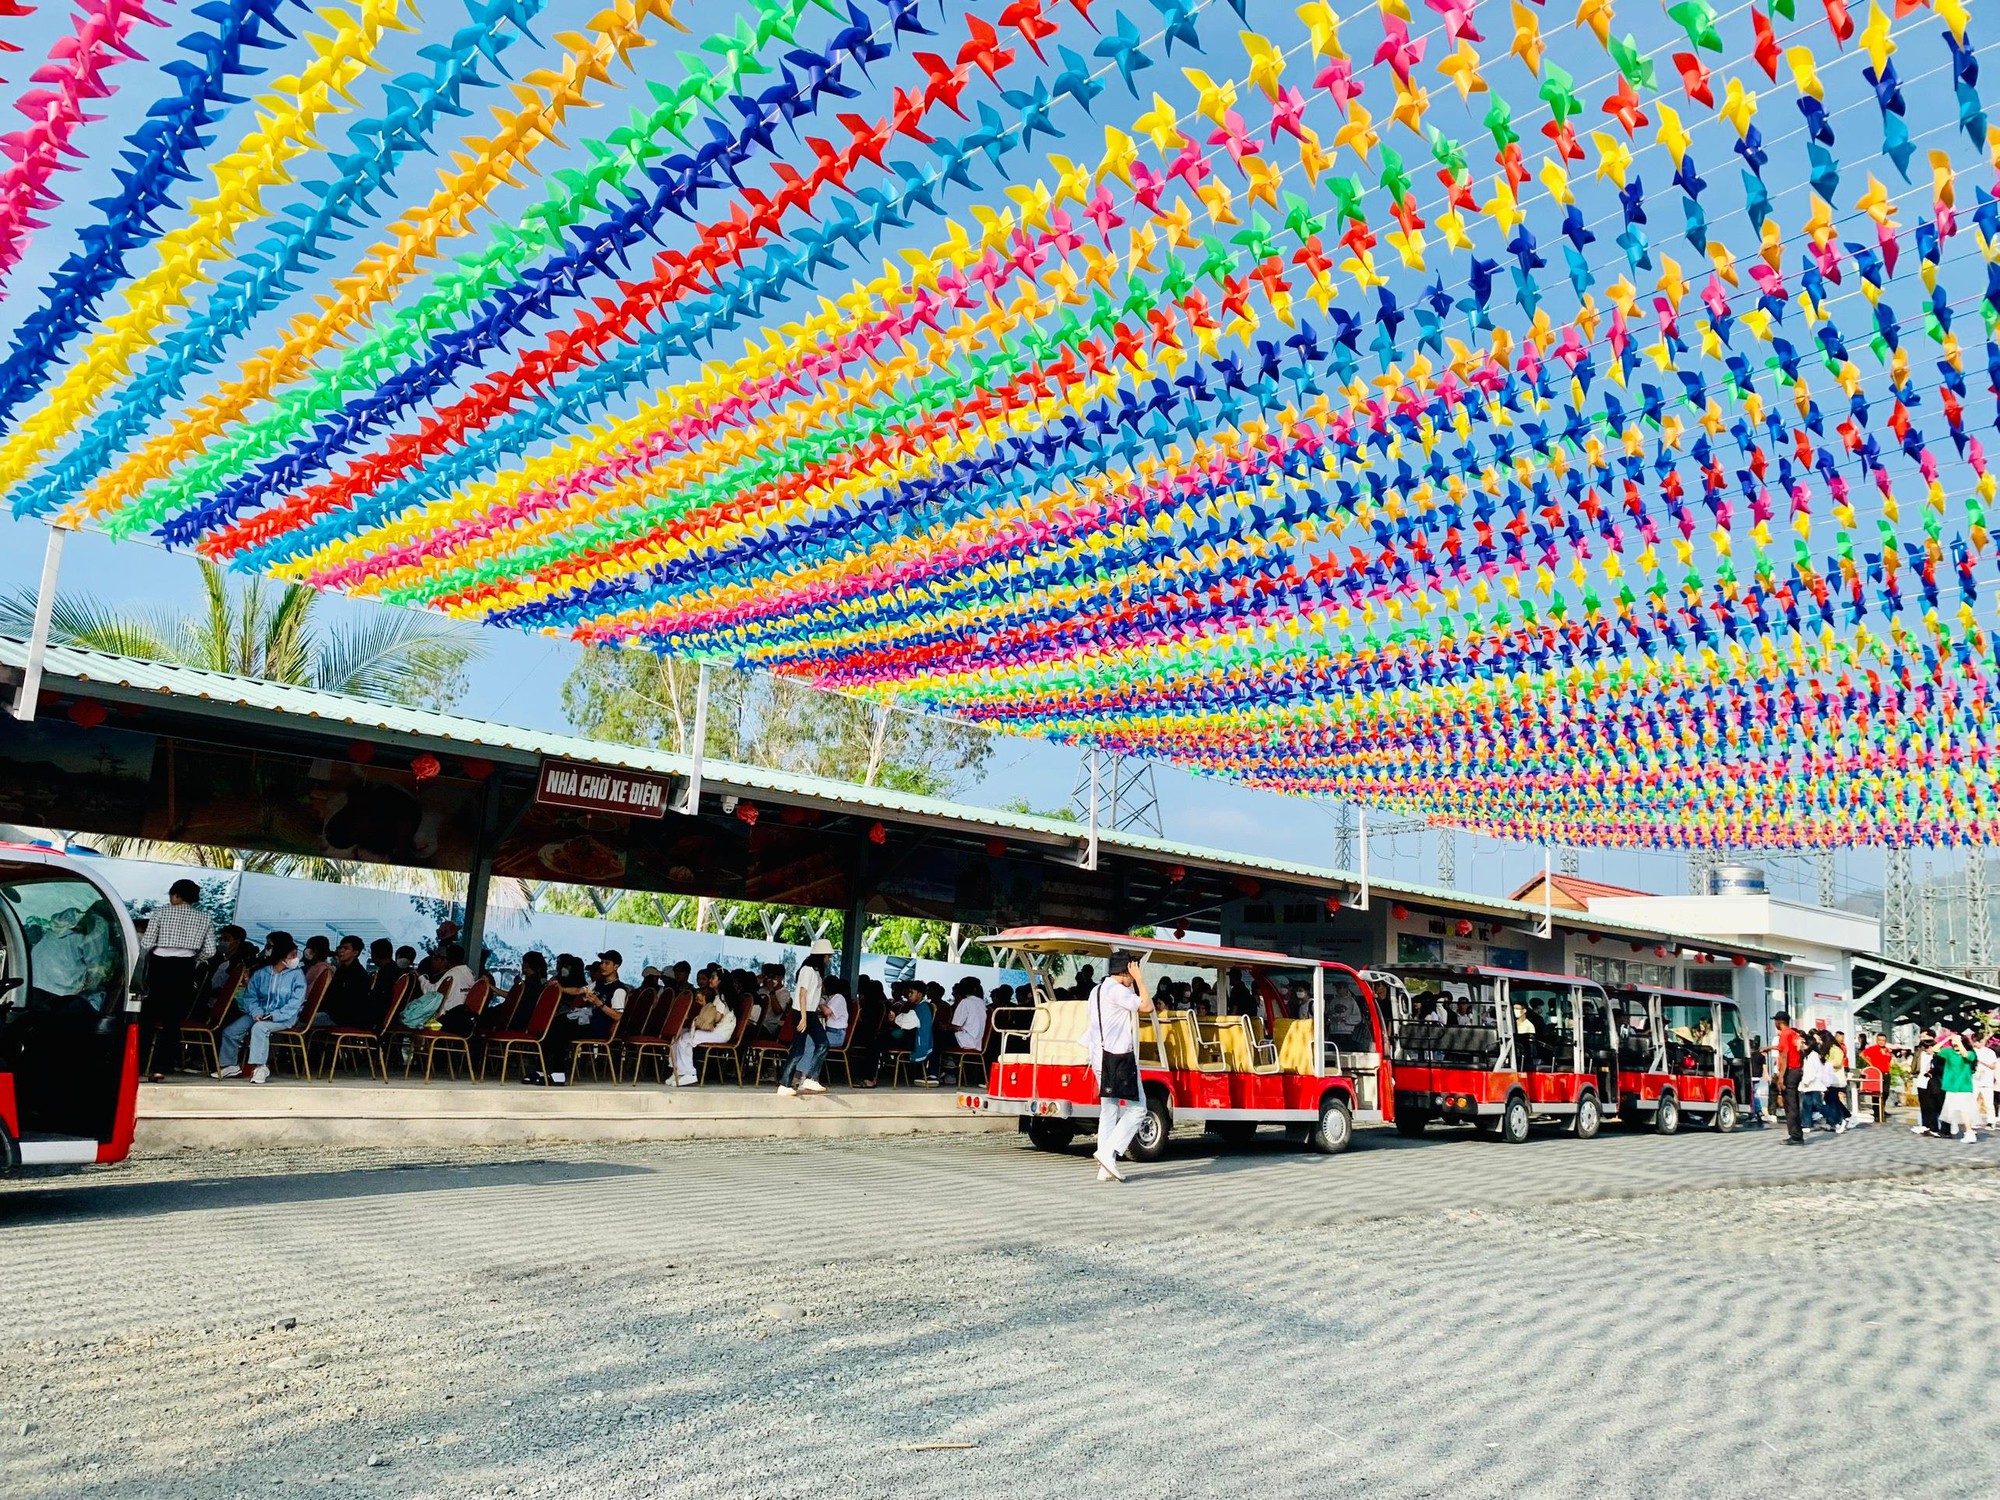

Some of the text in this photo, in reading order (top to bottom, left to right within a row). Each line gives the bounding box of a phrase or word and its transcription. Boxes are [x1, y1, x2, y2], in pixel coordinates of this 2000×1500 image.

[545, 769, 663, 811] NHÀ CHỜ XE ĐIỆN
